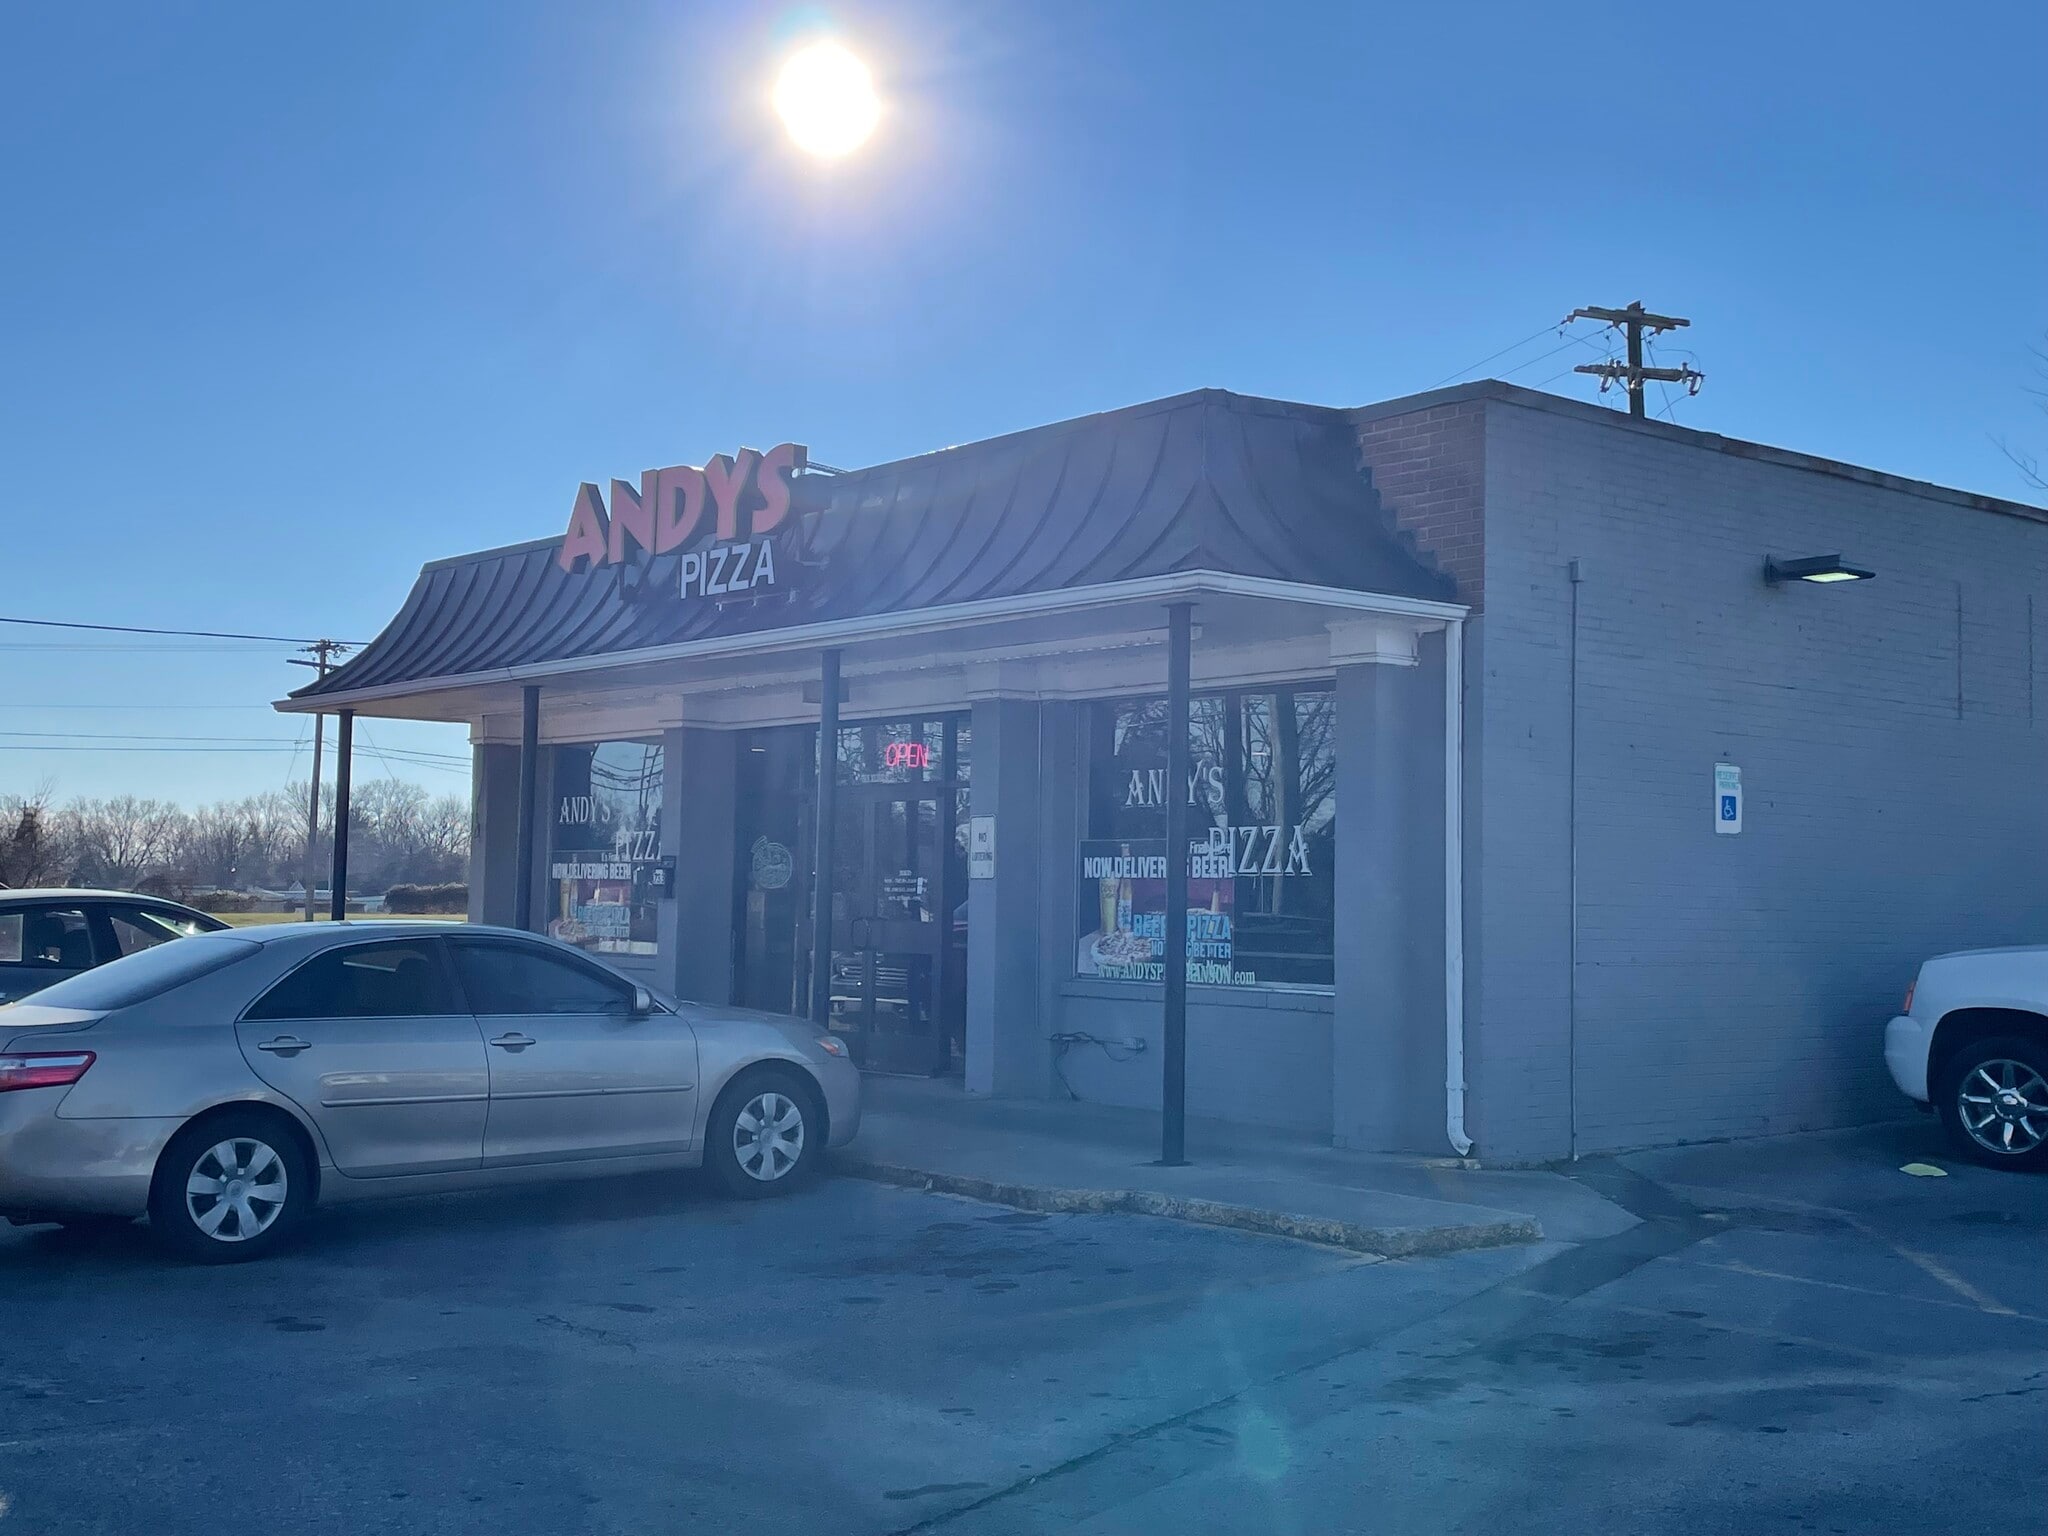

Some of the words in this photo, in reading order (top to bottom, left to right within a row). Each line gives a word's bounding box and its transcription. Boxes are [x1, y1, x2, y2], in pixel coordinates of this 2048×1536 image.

[680, 539, 776, 600] PIZZA
[885, 742, 929, 768] OPEN
[1125, 760, 1224, 808] ANY'S
[1084, 857, 1112, 879] NOW
[1208, 824, 1312, 876] PIZZA
[1186, 915, 1231, 939] PIZZA
